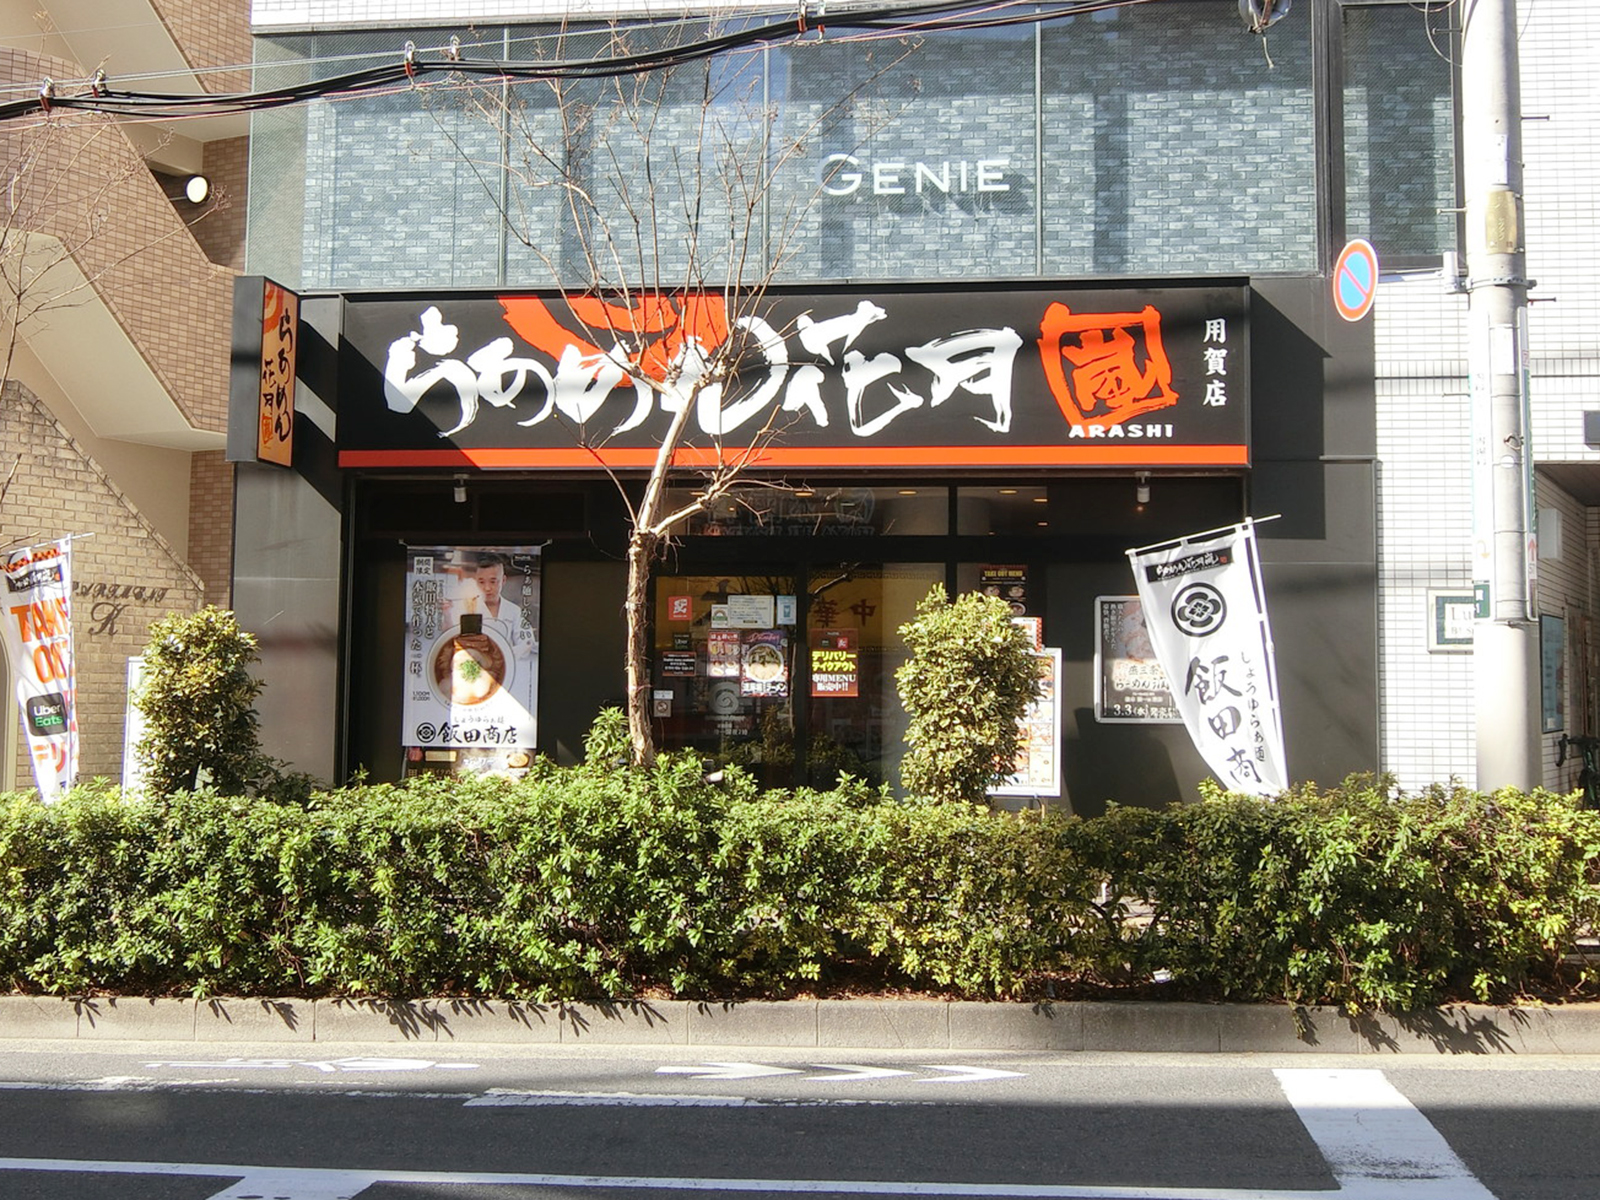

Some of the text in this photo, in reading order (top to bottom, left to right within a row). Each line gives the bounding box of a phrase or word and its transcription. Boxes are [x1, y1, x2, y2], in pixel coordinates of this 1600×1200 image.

[815, 153, 1010, 196] GENIE
[1203, 318, 1228, 407] 用賀店
[1068, 423, 1174, 438] ARASHI
[812, 651, 857, 661] デリバリー
[812, 661, 856, 672] テイクアウト
[33, 704, 61, 716] Uber
[35, 716, 63, 727] Eats
[1185, 655, 1272, 797] 飯田商
[437, 721, 518, 744] 飯田商店
